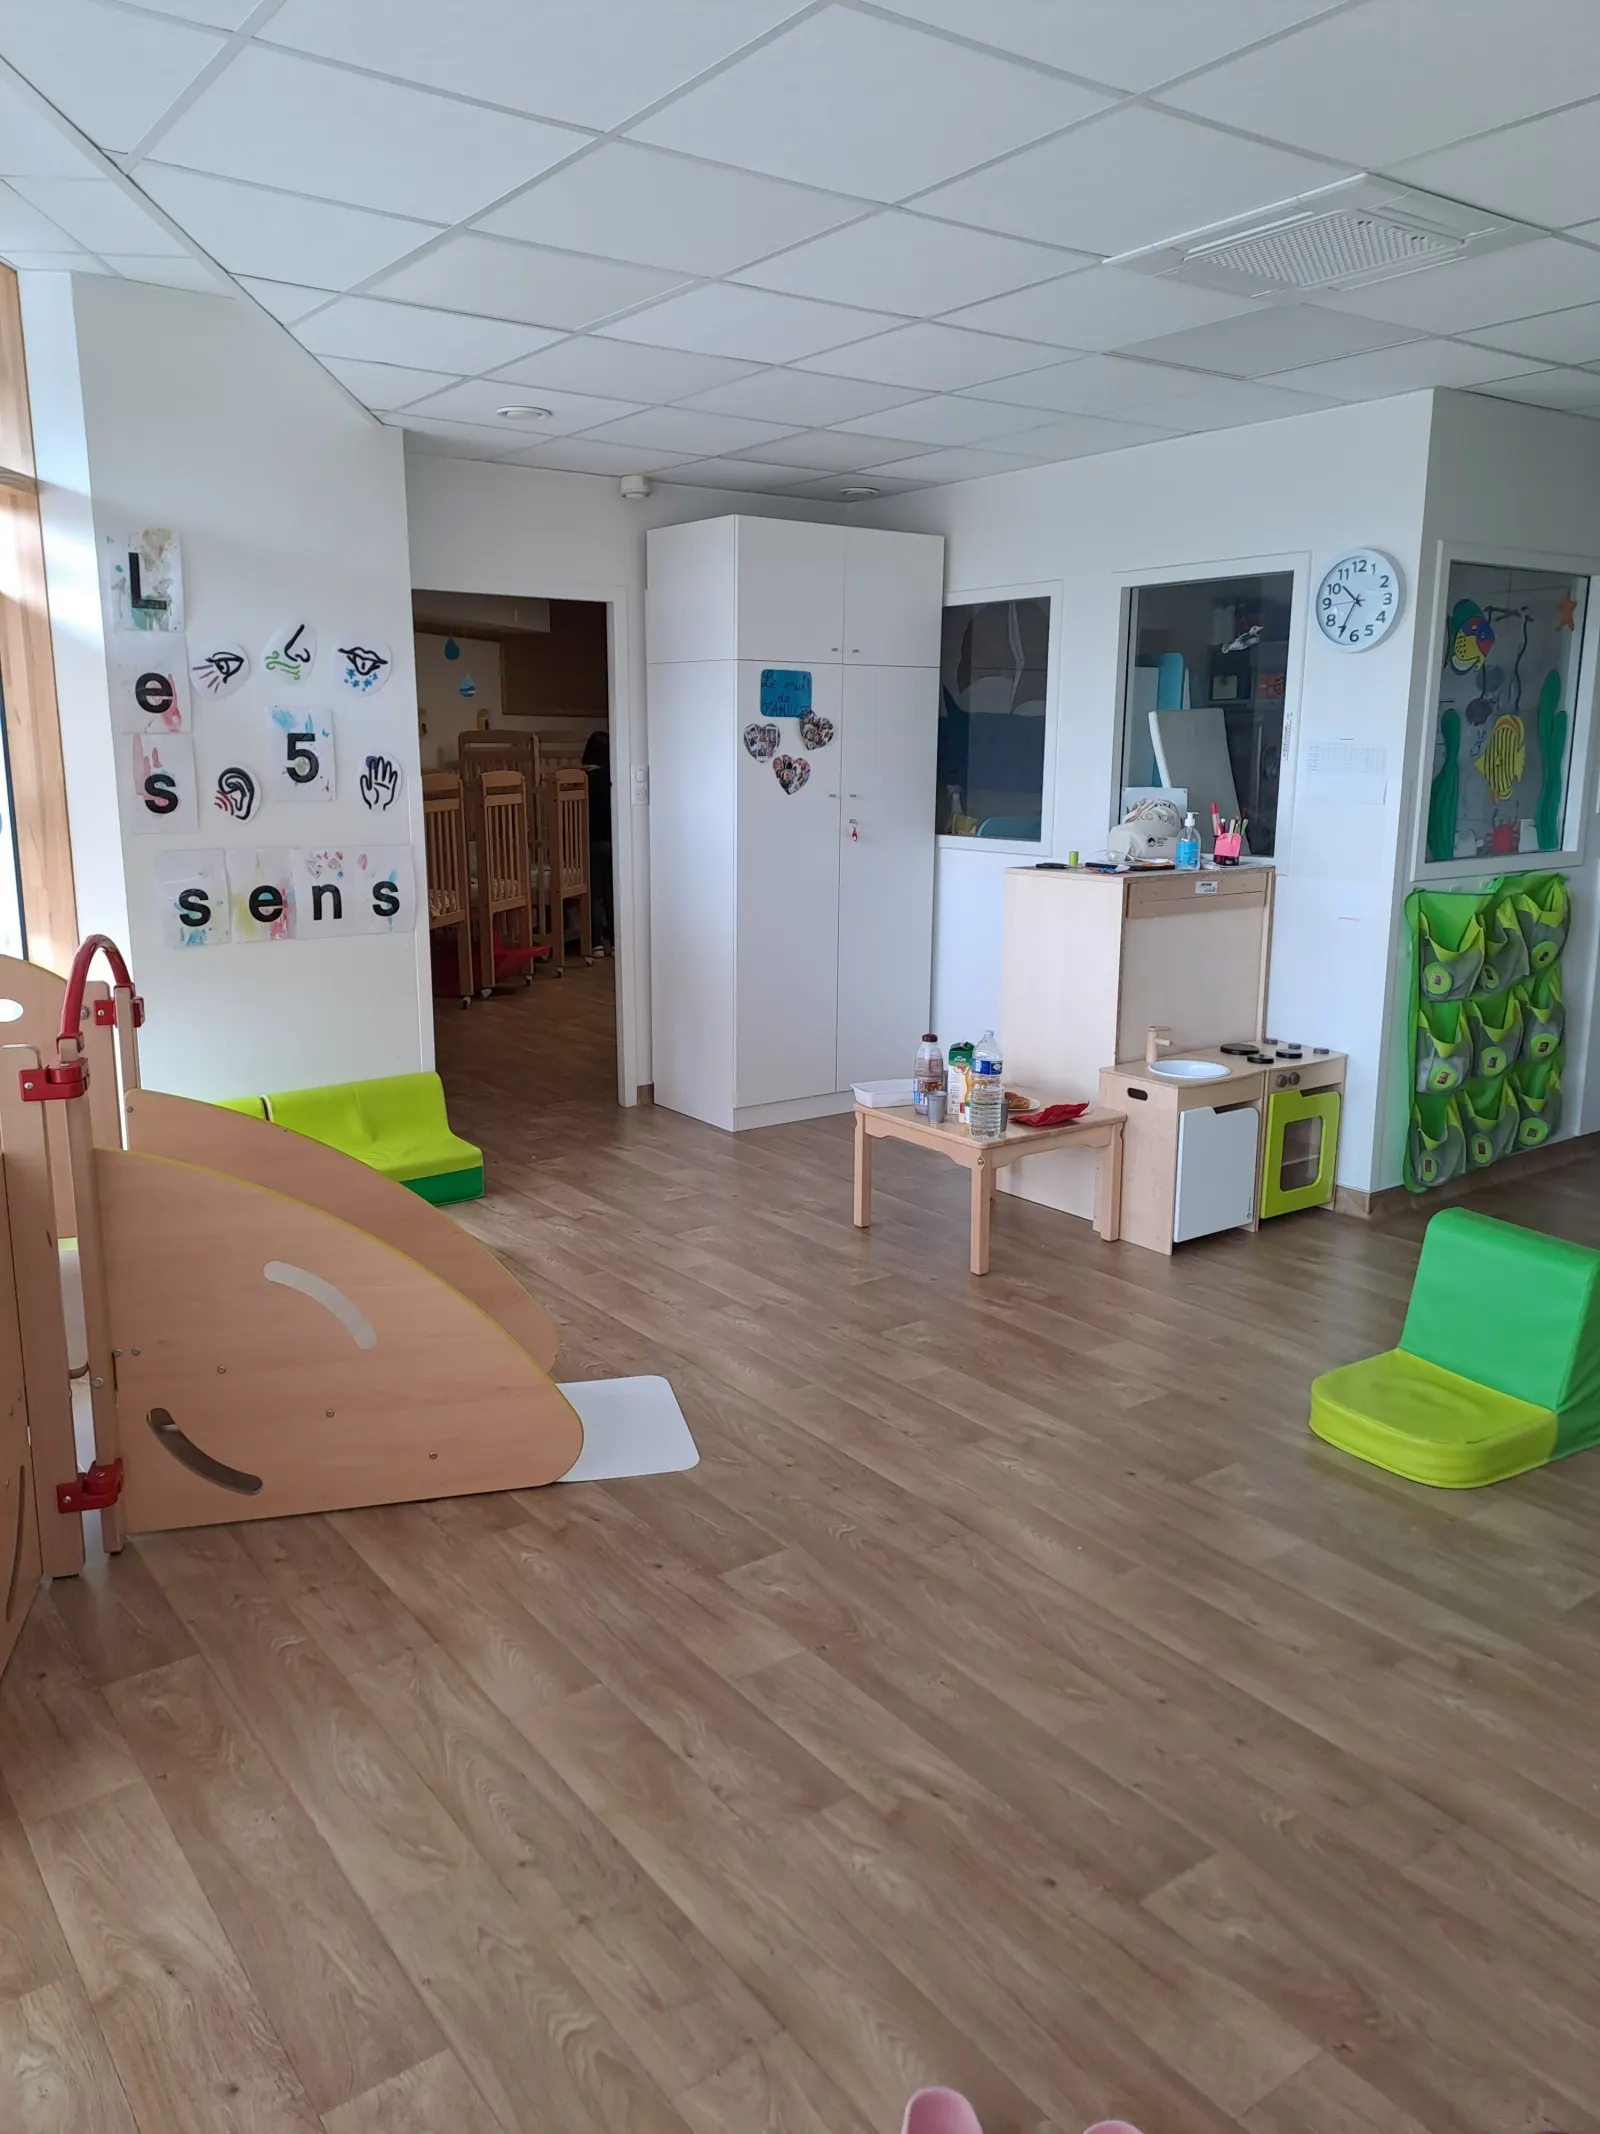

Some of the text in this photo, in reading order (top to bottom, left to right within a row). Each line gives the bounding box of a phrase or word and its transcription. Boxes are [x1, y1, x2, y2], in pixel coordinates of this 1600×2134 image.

[1352, 560, 1367, 573] 12
[1371, 563, 1376, 575] 1
[1337, 568, 1349, 580] 11
[1379, 575, 1389, 588] 2
[1327, 583, 1341, 595] 10
[1322, 597, 1332, 610] 9
[1383, 593, 1392, 605] 3
[1326, 614, 1336, 627] 8
[1375, 611, 1386, 623] 4
[1337, 625, 1347, 638] 7
[1349, 629, 1360, 642] 6
[1364, 624, 1374, 636] 5
[286, 732, 320, 784] 5
[178, 880, 401, 928] sens
